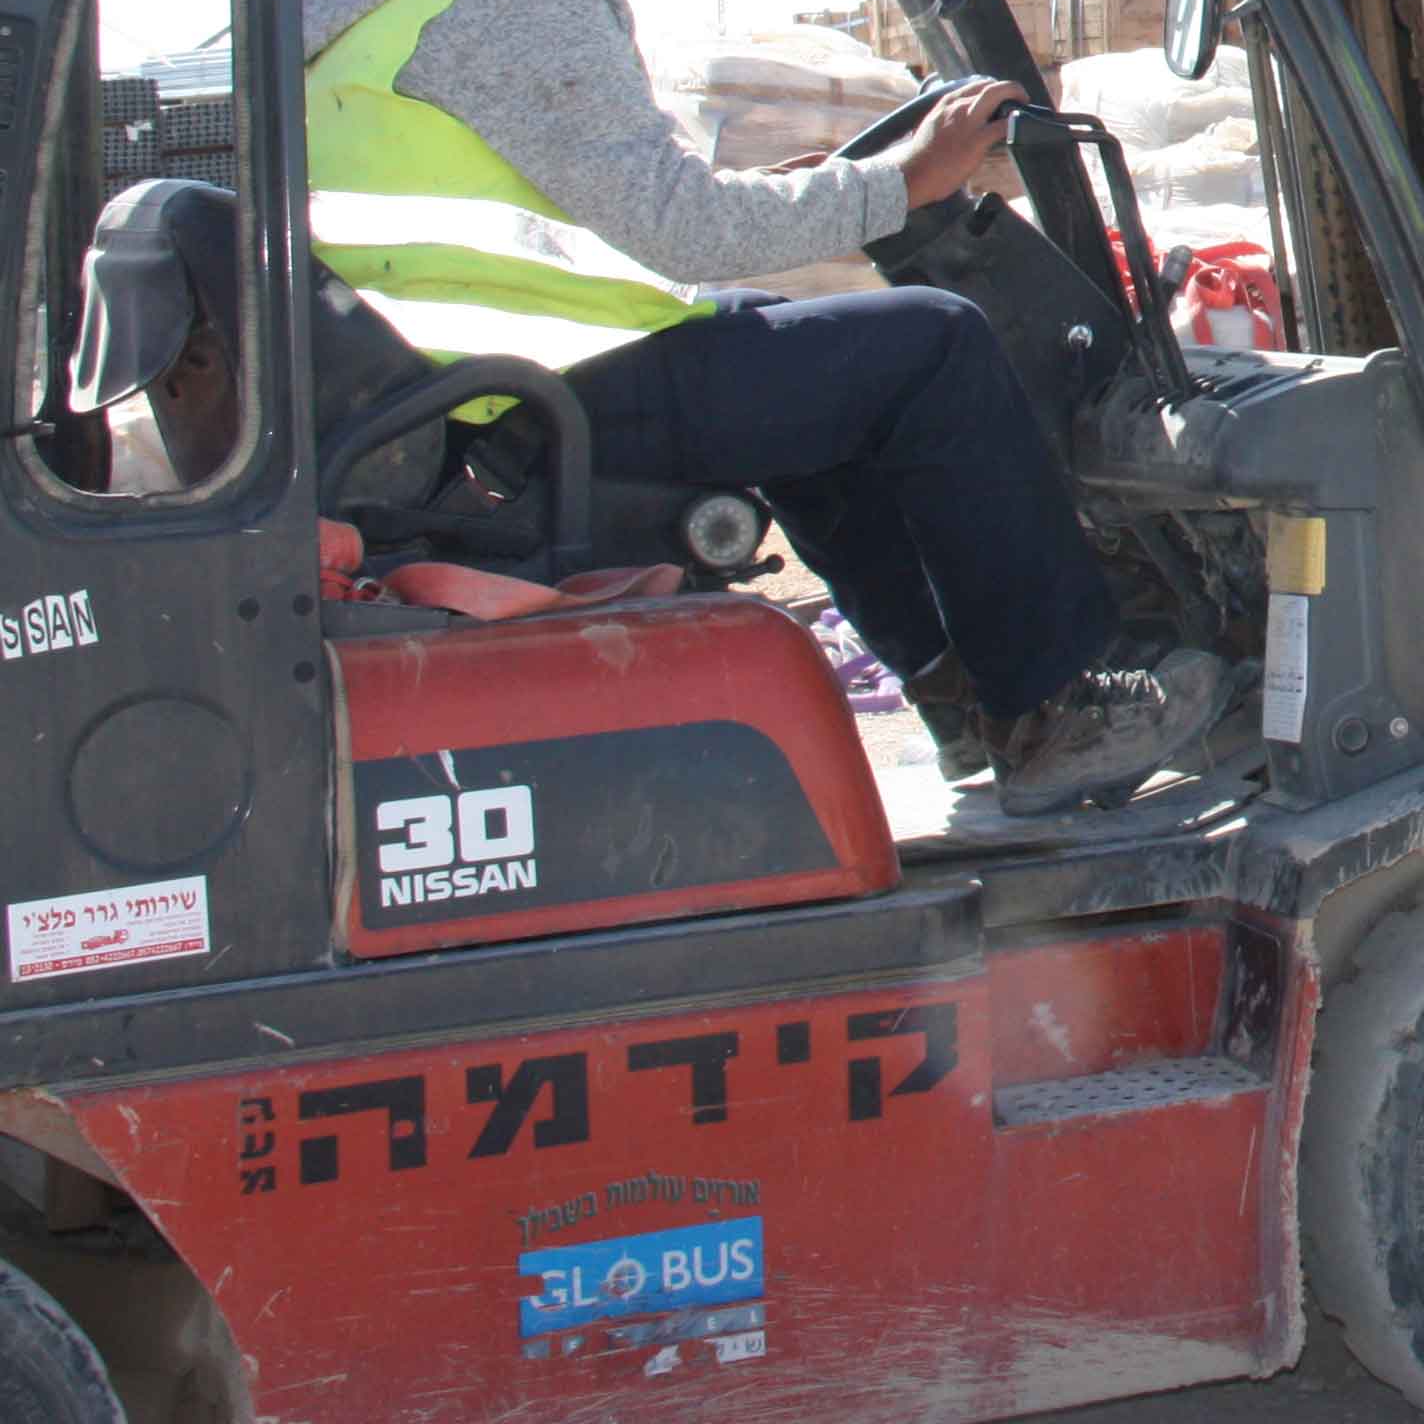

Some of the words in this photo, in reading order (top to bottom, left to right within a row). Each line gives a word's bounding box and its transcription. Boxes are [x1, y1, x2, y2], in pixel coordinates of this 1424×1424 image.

[377, 785, 534, 873] 30
[380, 859, 538, 908] NISSAN
[82, 902, 119, 924] גרר
[126, 889, 197, 917] שירותי
